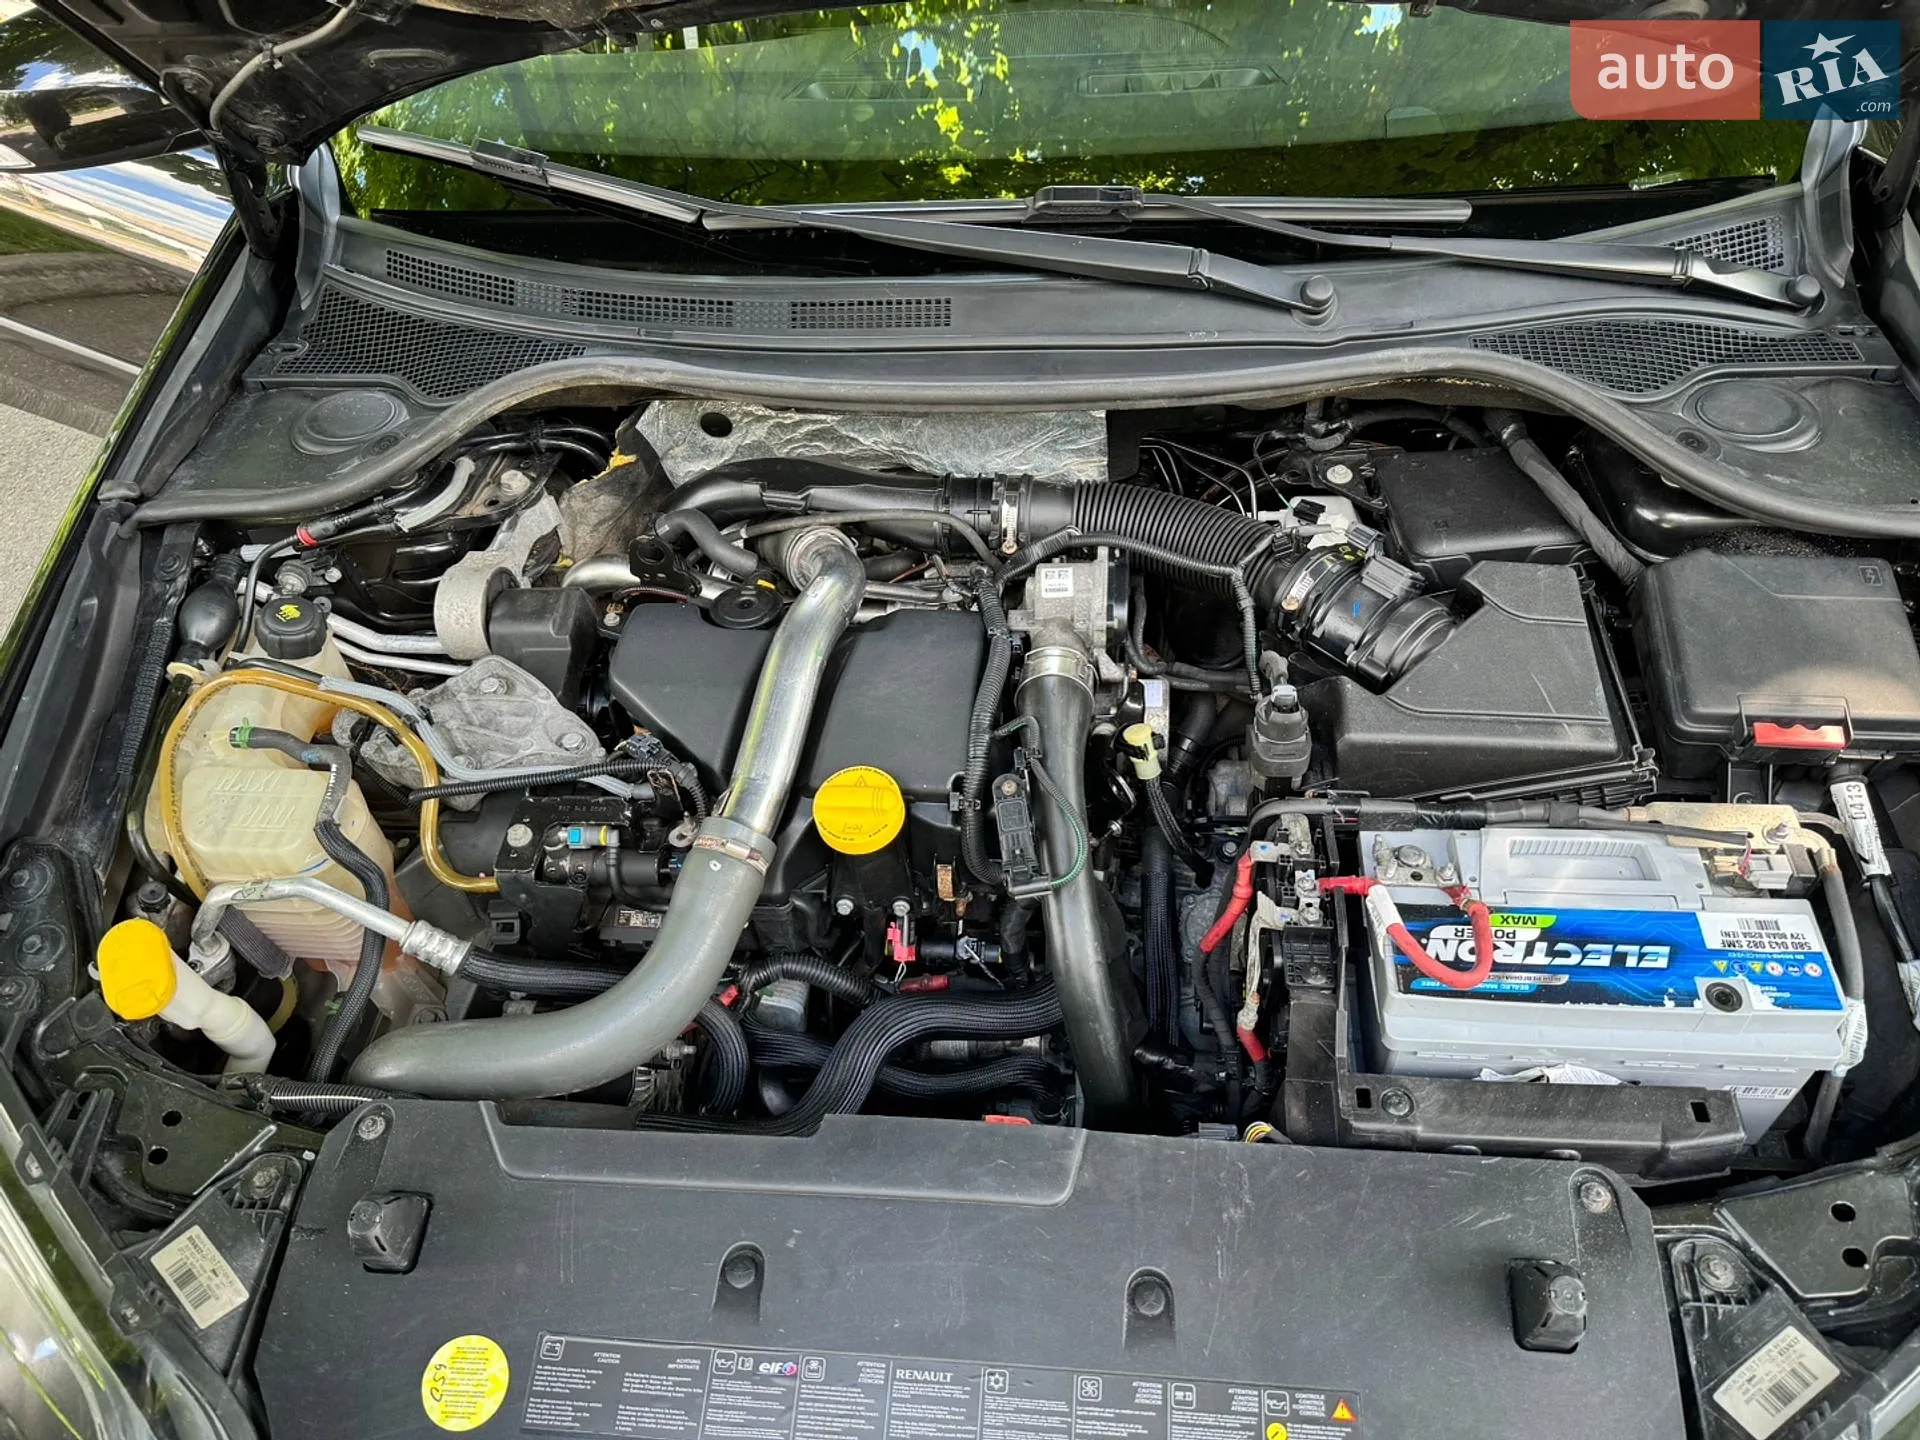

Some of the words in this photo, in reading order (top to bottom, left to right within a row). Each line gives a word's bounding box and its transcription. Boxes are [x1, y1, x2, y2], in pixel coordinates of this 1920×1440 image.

[1500, 914, 1538, 926] MAX
[1454, 927, 1517, 940] POER
[1720, 938, 1743, 949] SMF
[1746, 939, 1766, 950] 082
[1767, 940, 1789, 950] 043
[1791, 941, 1812, 951] 580
[758, 1362, 784, 1374] elf
[895, 1368, 954, 1383] RENAULT
